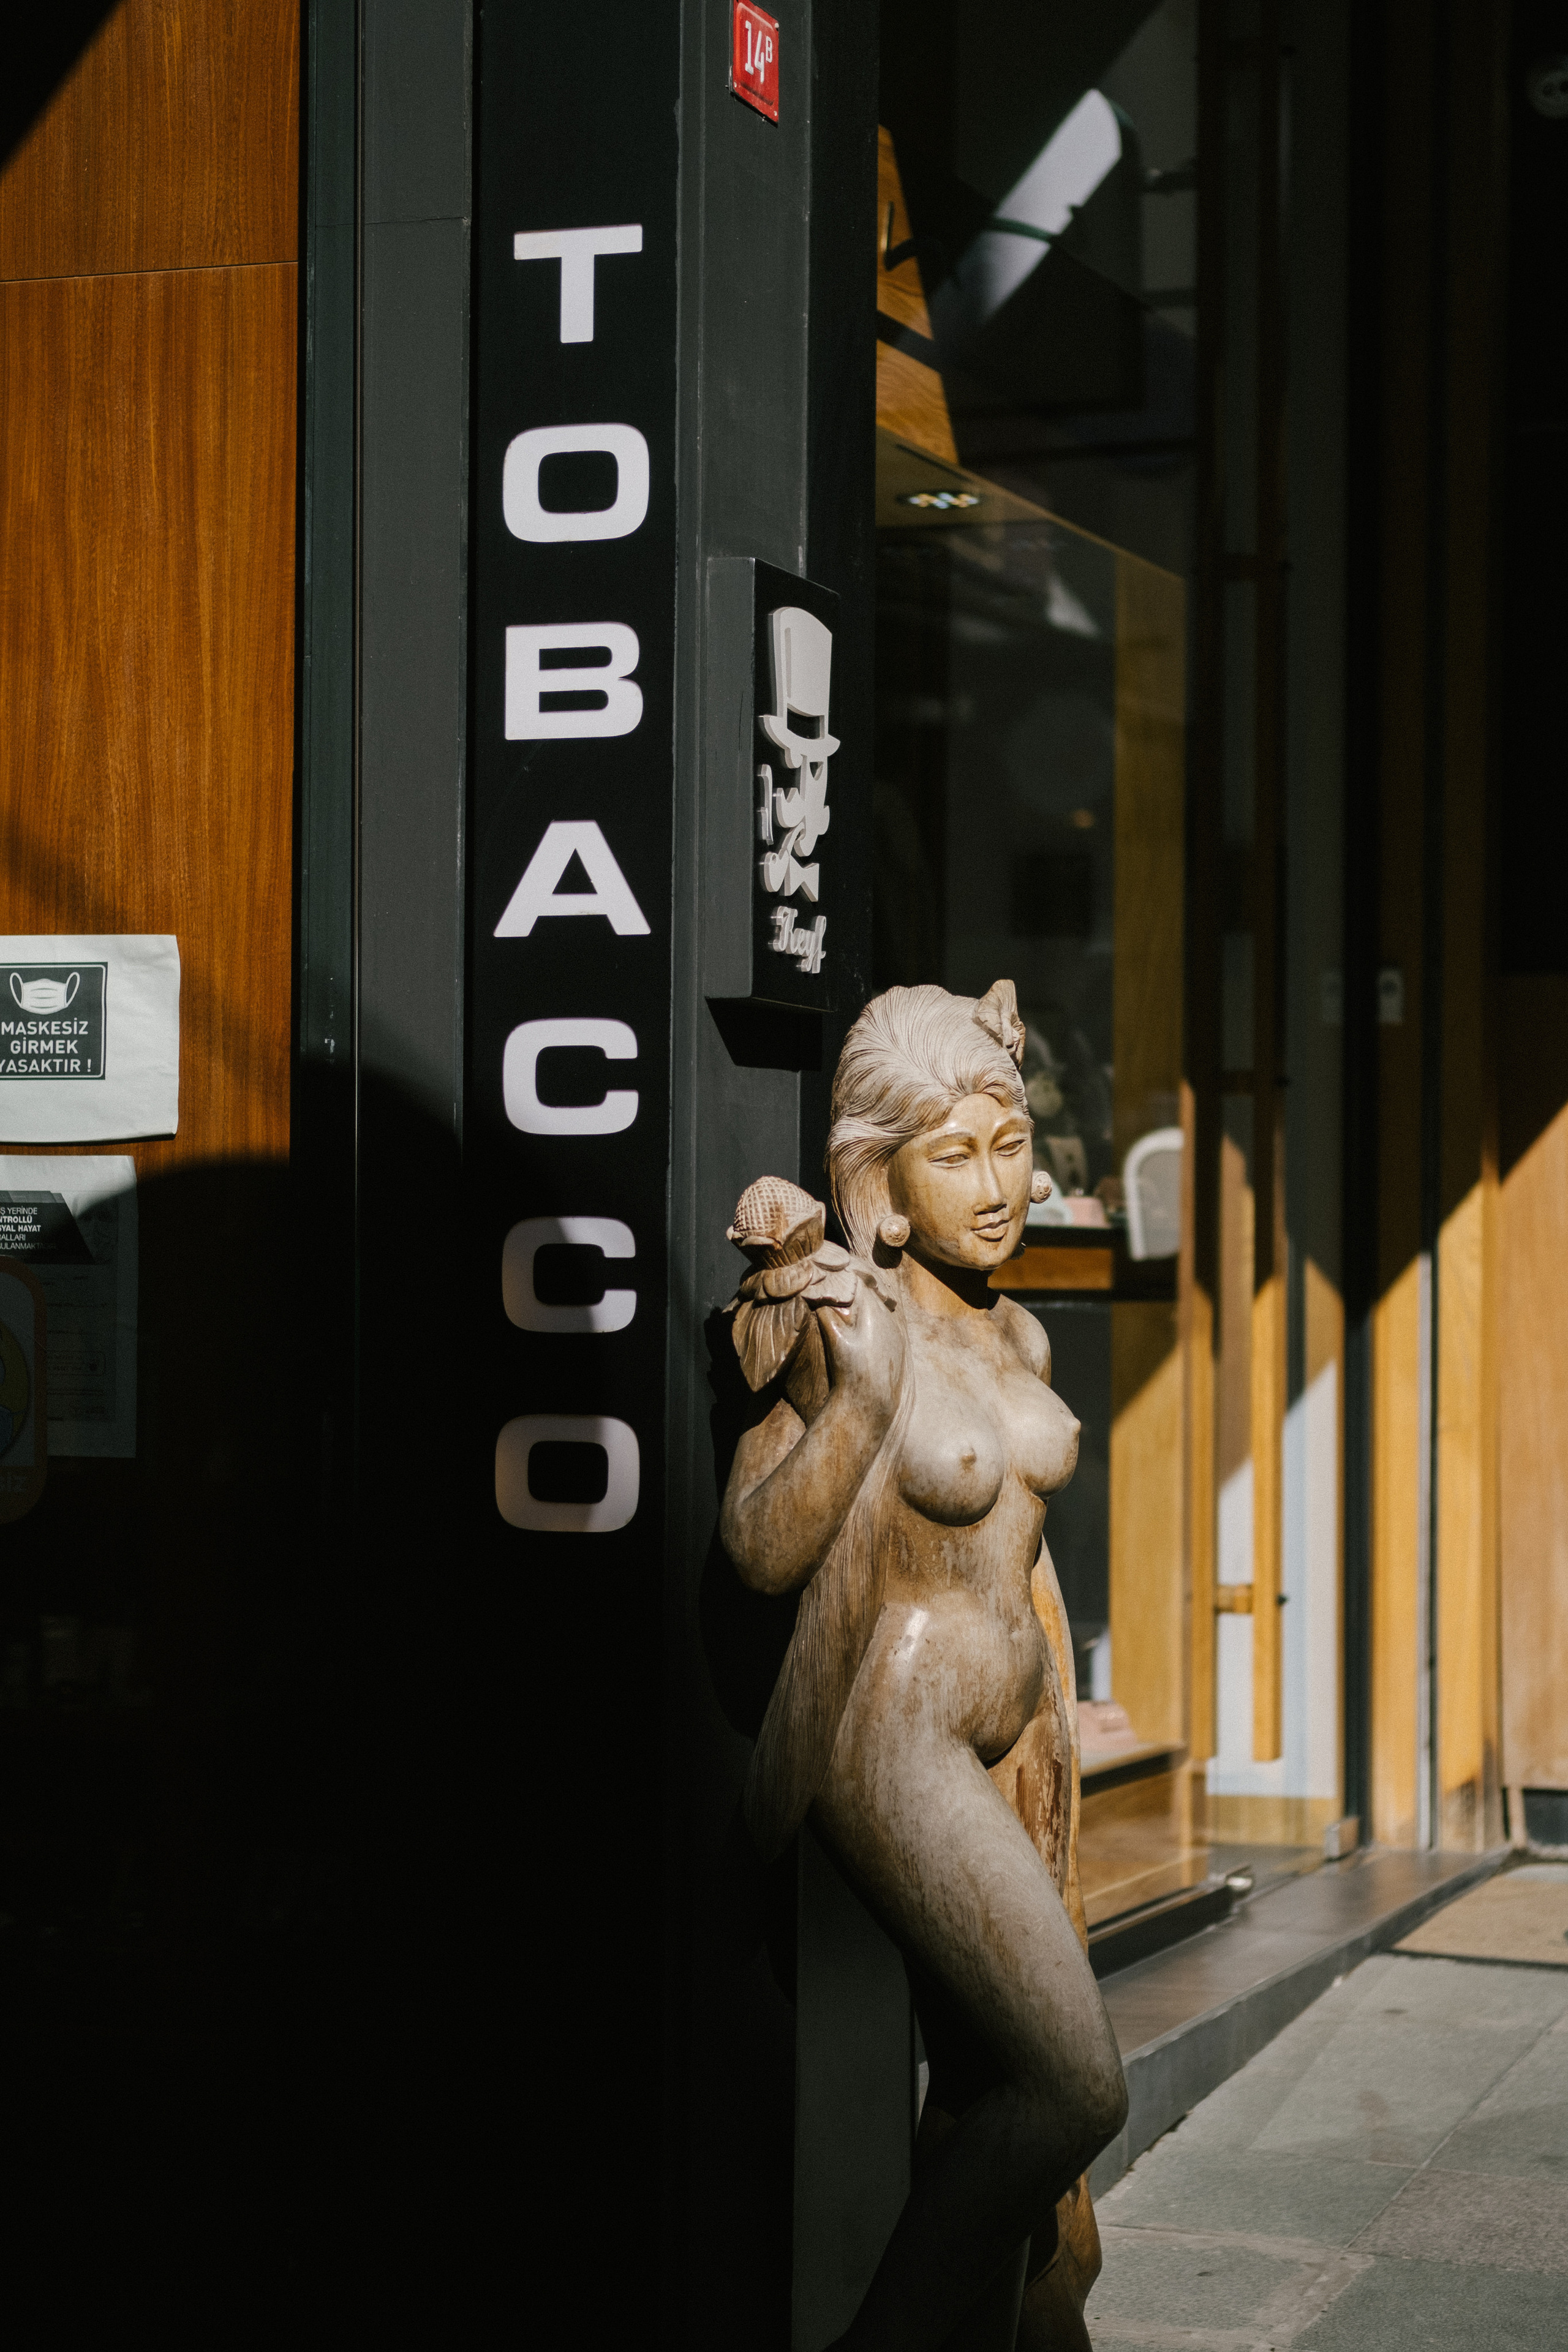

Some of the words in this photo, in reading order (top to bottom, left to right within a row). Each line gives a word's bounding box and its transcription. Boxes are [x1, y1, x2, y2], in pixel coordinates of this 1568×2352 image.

[493, 224, 651, 1533] TOBACCO
[1, 1017, 89, 1035] MASKESİZ
[10, 1037, 78, 1054] GİRMEK
[7, 1205, 37, 1215] YERİNDE
